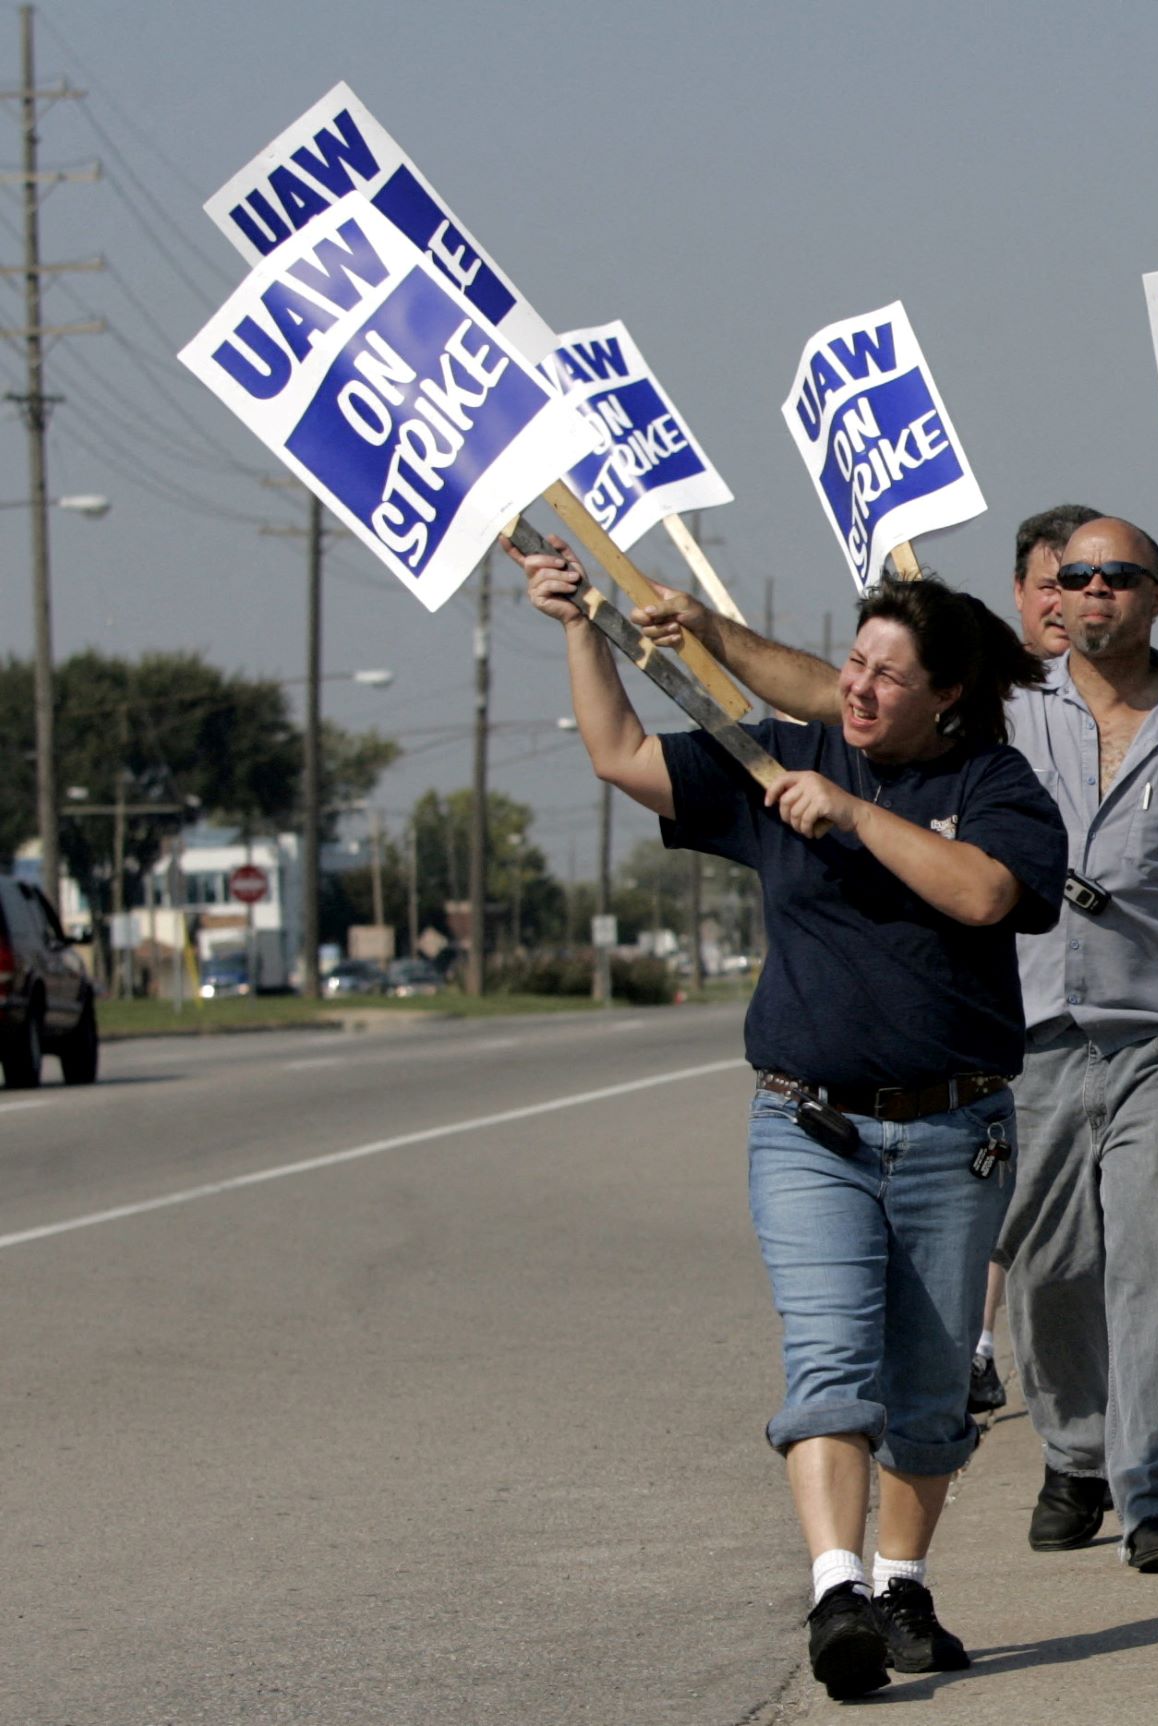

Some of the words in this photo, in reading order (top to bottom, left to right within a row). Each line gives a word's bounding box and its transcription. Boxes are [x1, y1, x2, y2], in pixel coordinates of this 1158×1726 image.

[228, 108, 381, 257] UAW
[211, 217, 391, 400] UAW
[337, 330, 417, 446] ON
[371, 318, 509, 567] STRIKE
[796, 321, 897, 443] UAW
[833, 397, 880, 482] ON
[584, 413, 688, 530] STRIKE
[848, 409, 949, 578] STRIKE
